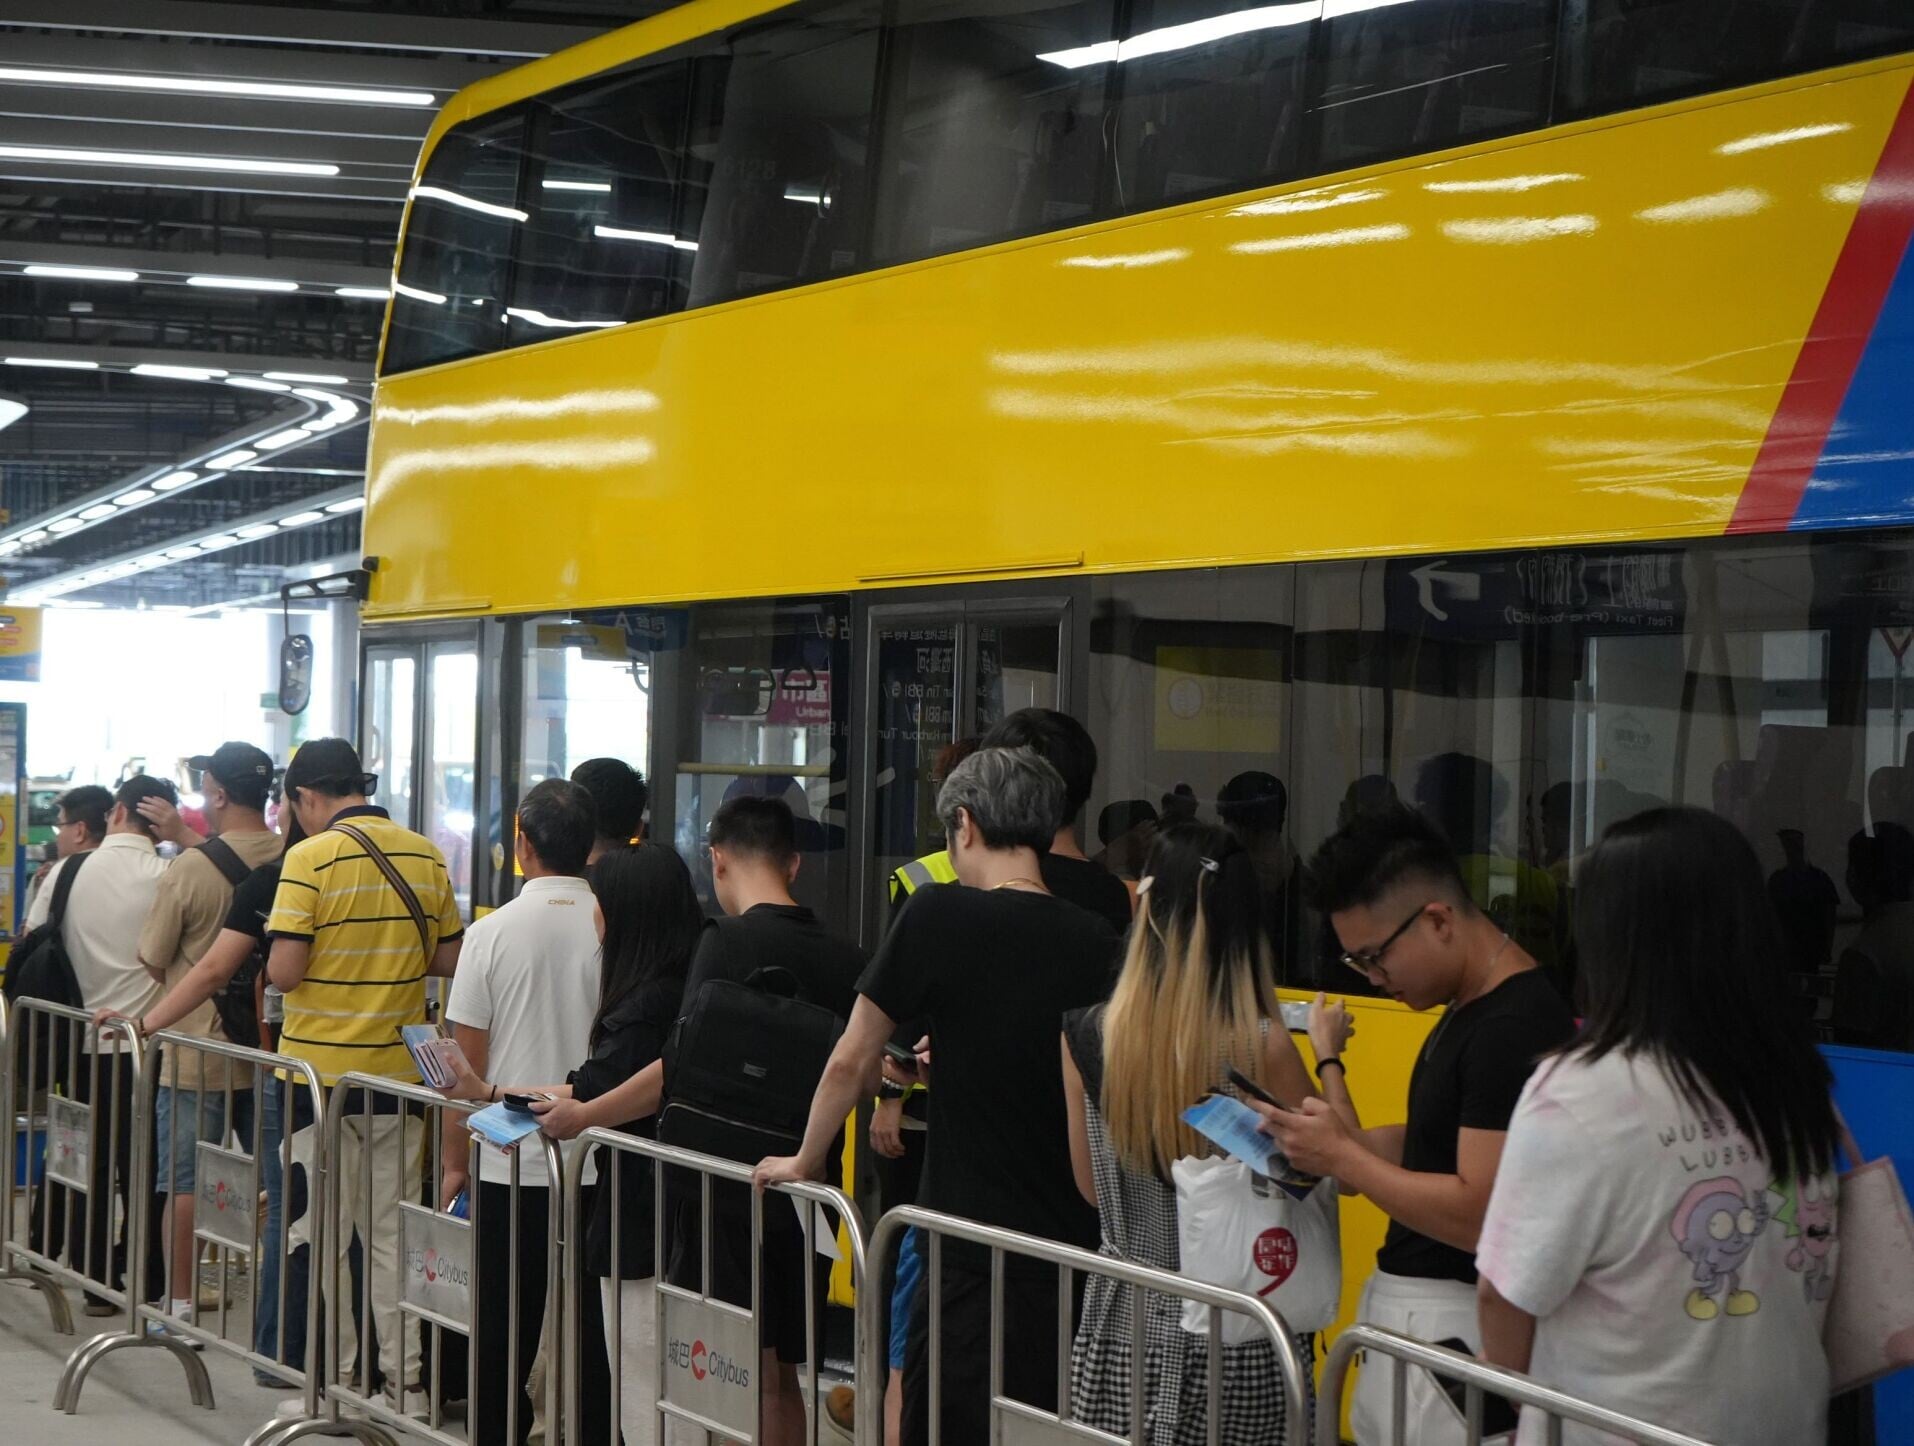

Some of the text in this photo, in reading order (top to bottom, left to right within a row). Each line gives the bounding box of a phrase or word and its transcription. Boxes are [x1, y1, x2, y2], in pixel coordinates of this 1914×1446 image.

[1658, 1118, 1732, 1148] WUBB
[1679, 1143, 1750, 1172] LUBB
[667, 1337, 750, 1388] 城巴 Citybus
